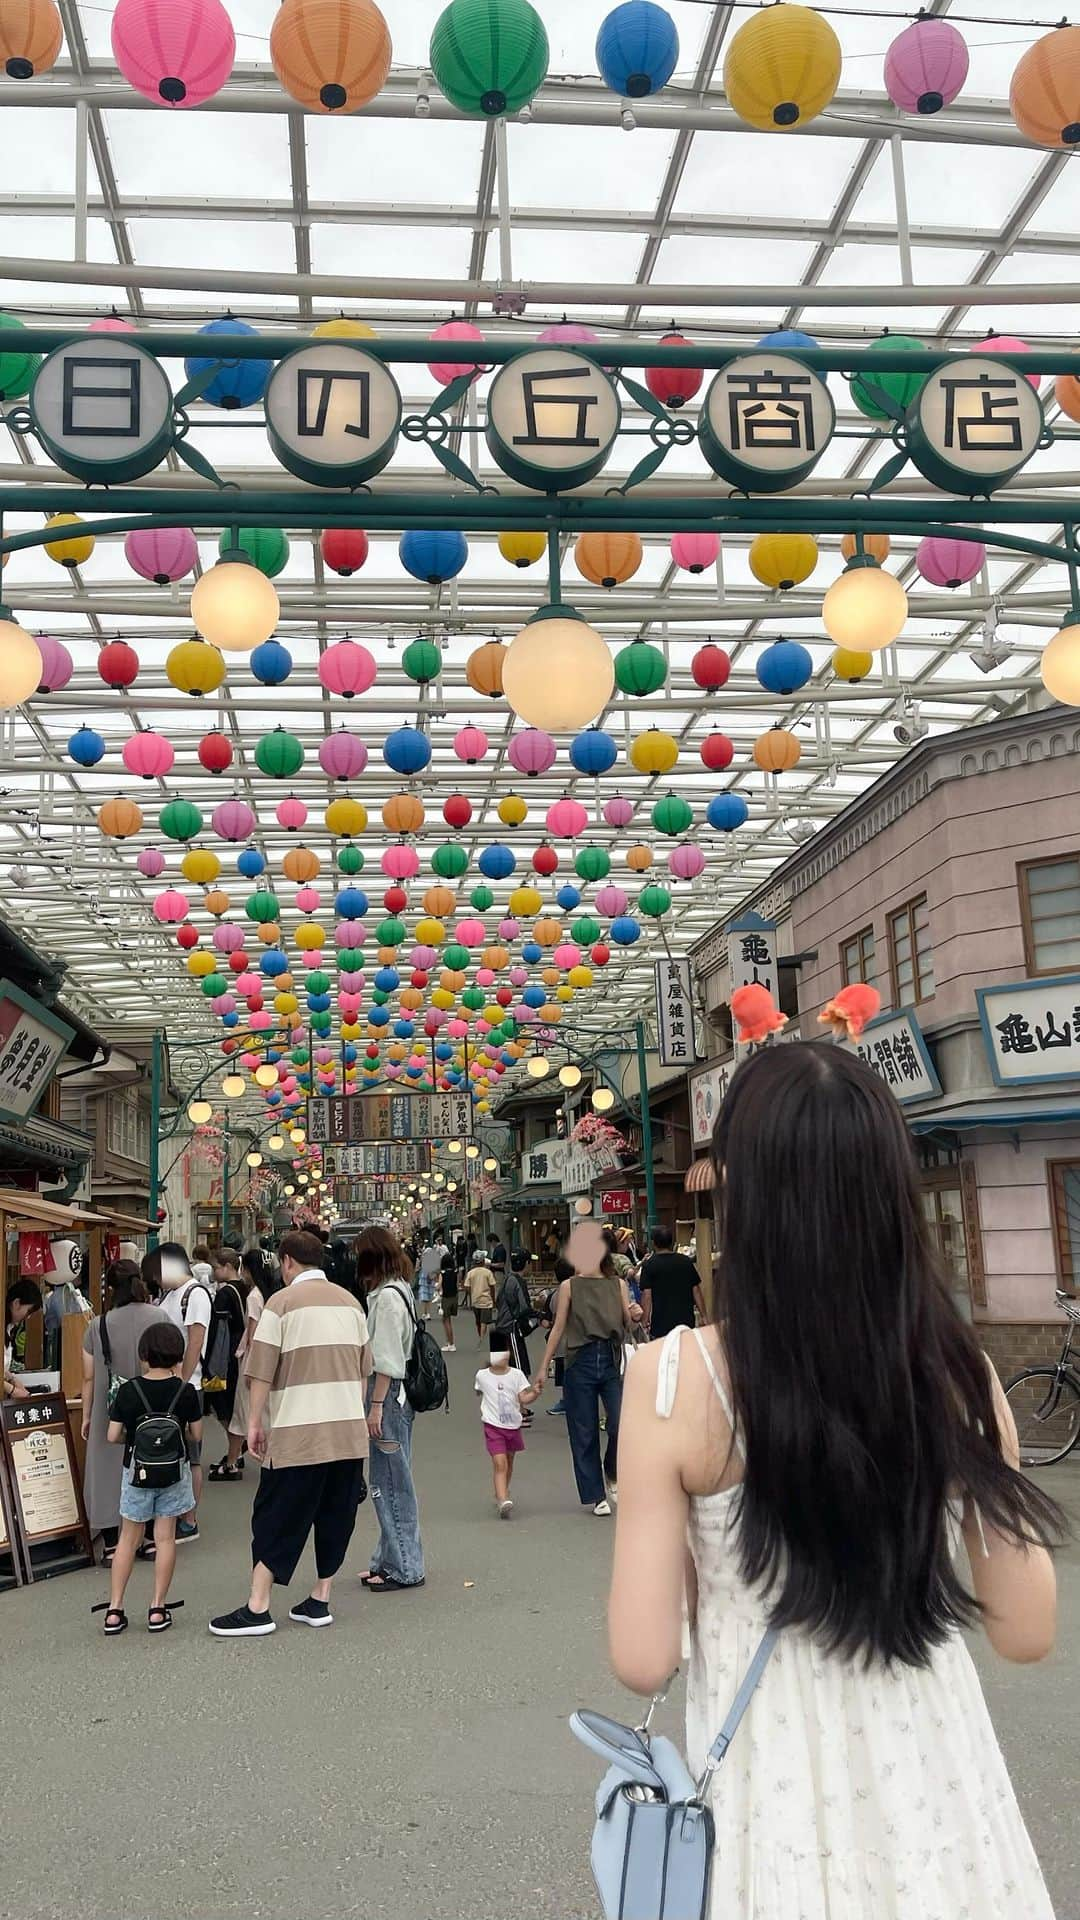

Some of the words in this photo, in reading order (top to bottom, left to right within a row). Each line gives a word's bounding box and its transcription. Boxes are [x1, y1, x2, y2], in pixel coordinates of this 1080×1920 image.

[455, 1101, 469, 1135] 夢見堂
[14, 1406, 53, 1425] 営業中
